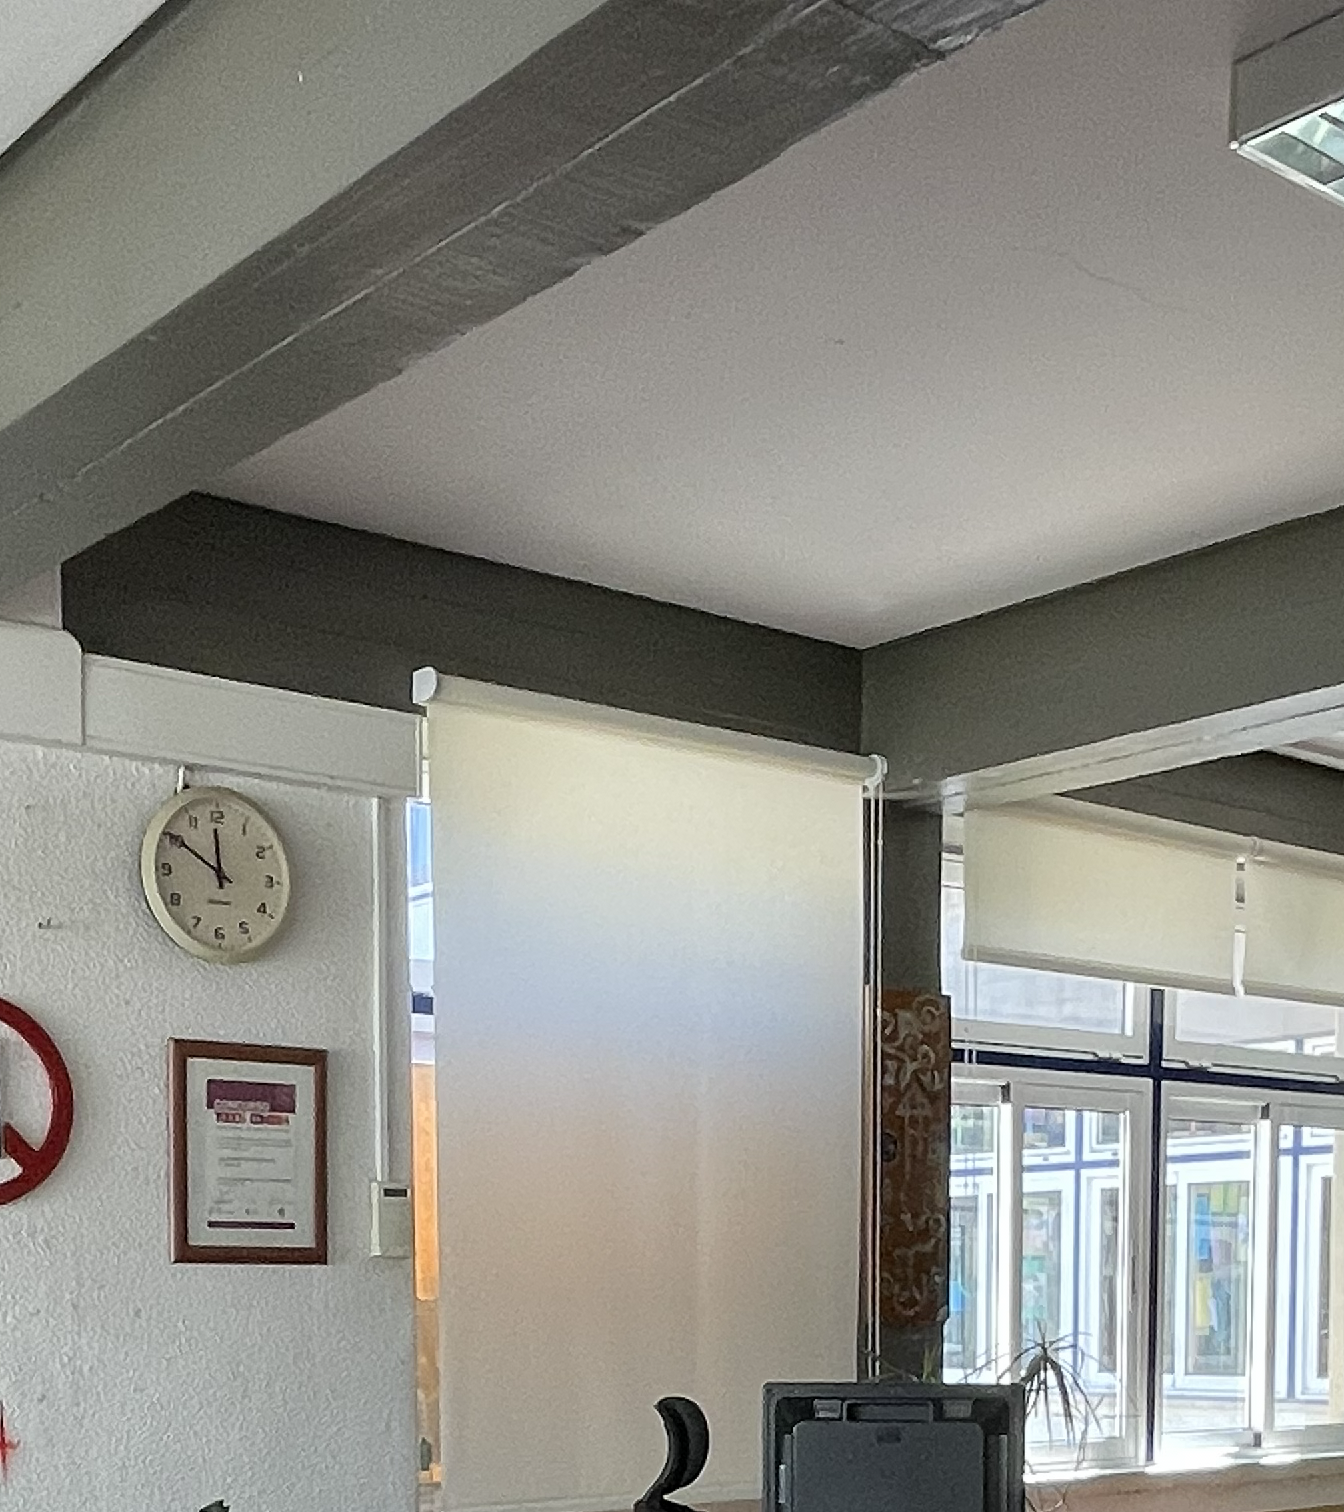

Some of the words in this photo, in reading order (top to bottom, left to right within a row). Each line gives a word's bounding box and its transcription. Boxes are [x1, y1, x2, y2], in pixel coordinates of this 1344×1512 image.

[209, 810, 226, 826] 12
[255, 845, 267, 860] 2
[160, 862, 173, 877] 9
[264, 874, 275, 889] 3
[169, 892, 182, 907] 8
[256, 902, 268, 915] 4
[190, 915, 203, 929] 7
[238, 920, 251, 935] 5
[214, 926, 227, 941] 6
